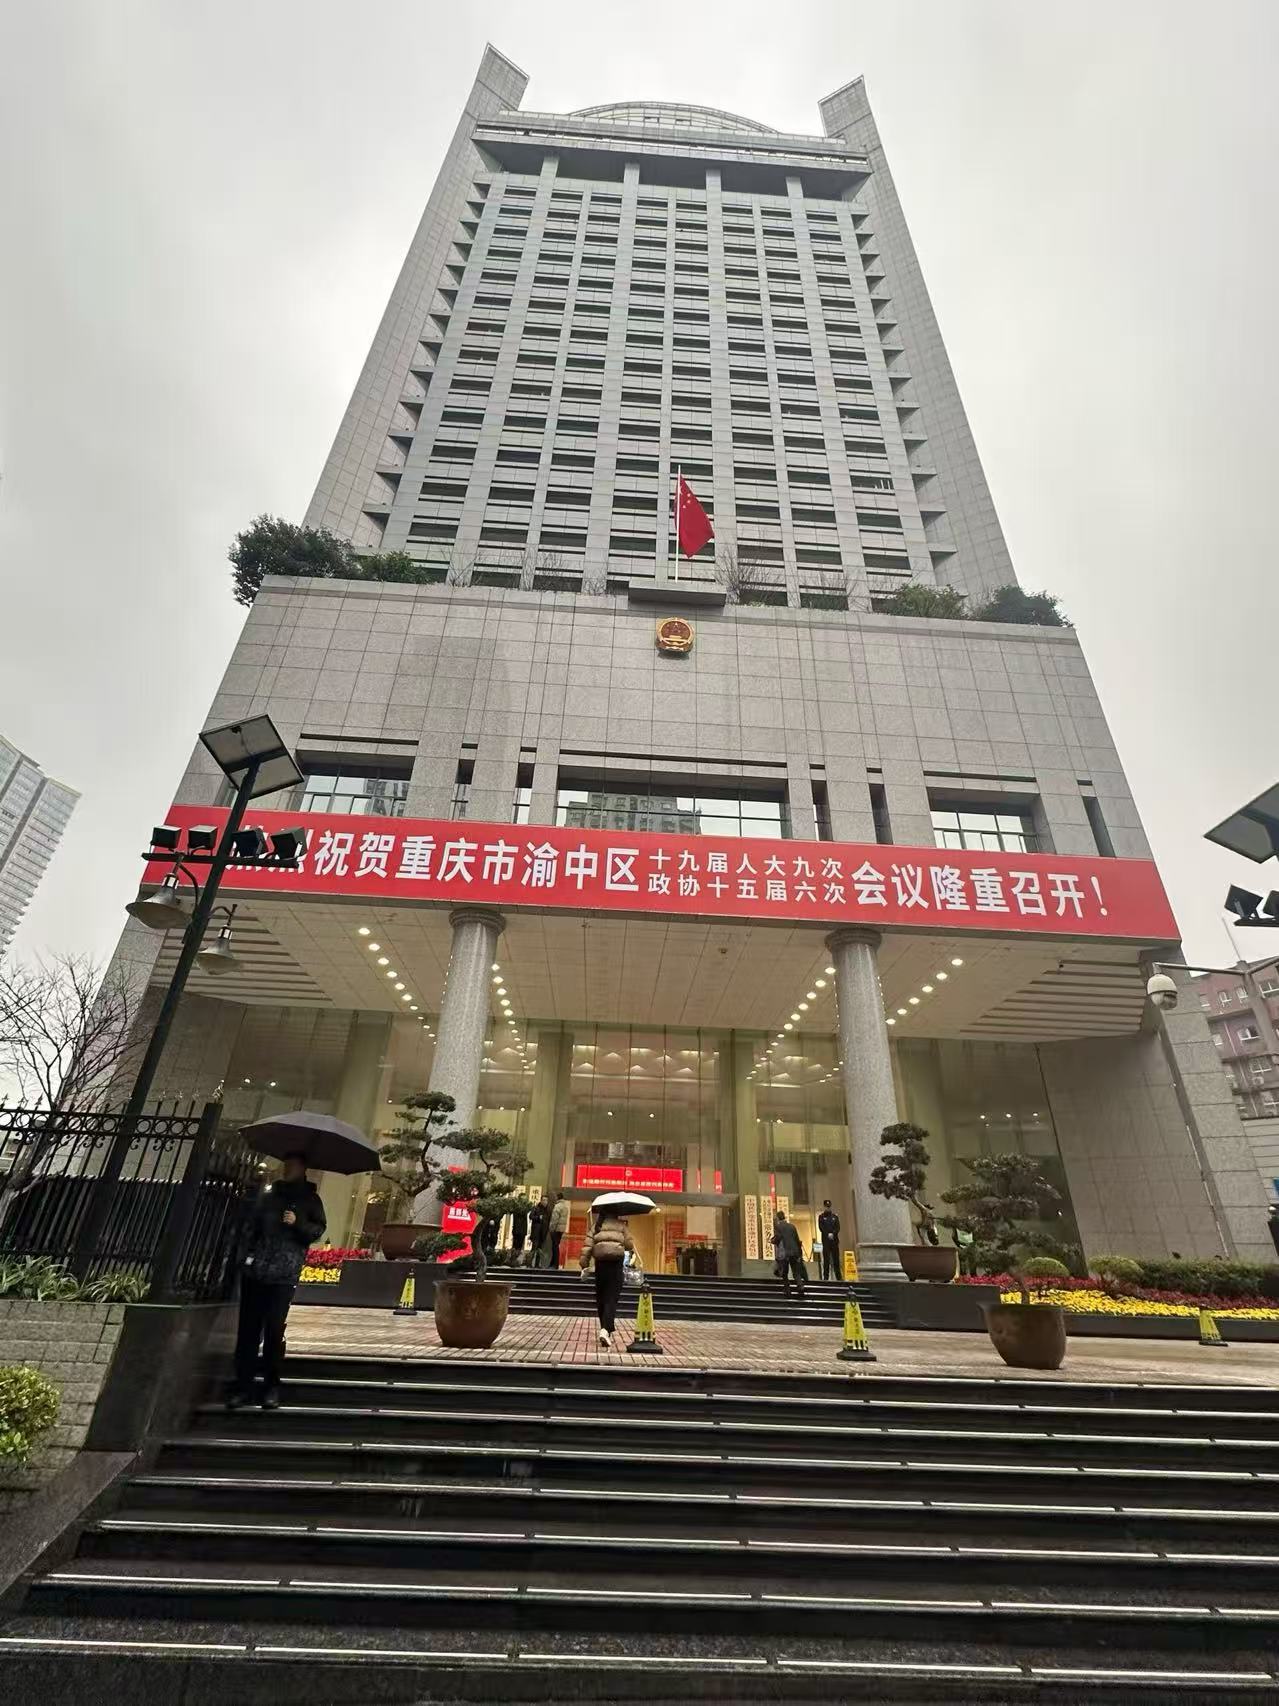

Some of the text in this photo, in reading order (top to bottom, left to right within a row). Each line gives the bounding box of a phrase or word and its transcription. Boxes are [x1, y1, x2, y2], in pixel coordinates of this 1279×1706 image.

[224, 825, 639, 891] 祝贺重庆市渝中区
[649, 850, 844, 880] 十九届人大九次
[648, 872, 846, 905] 政协十五届六次
[851, 861, 1109, 918] 会议隆重召开！
